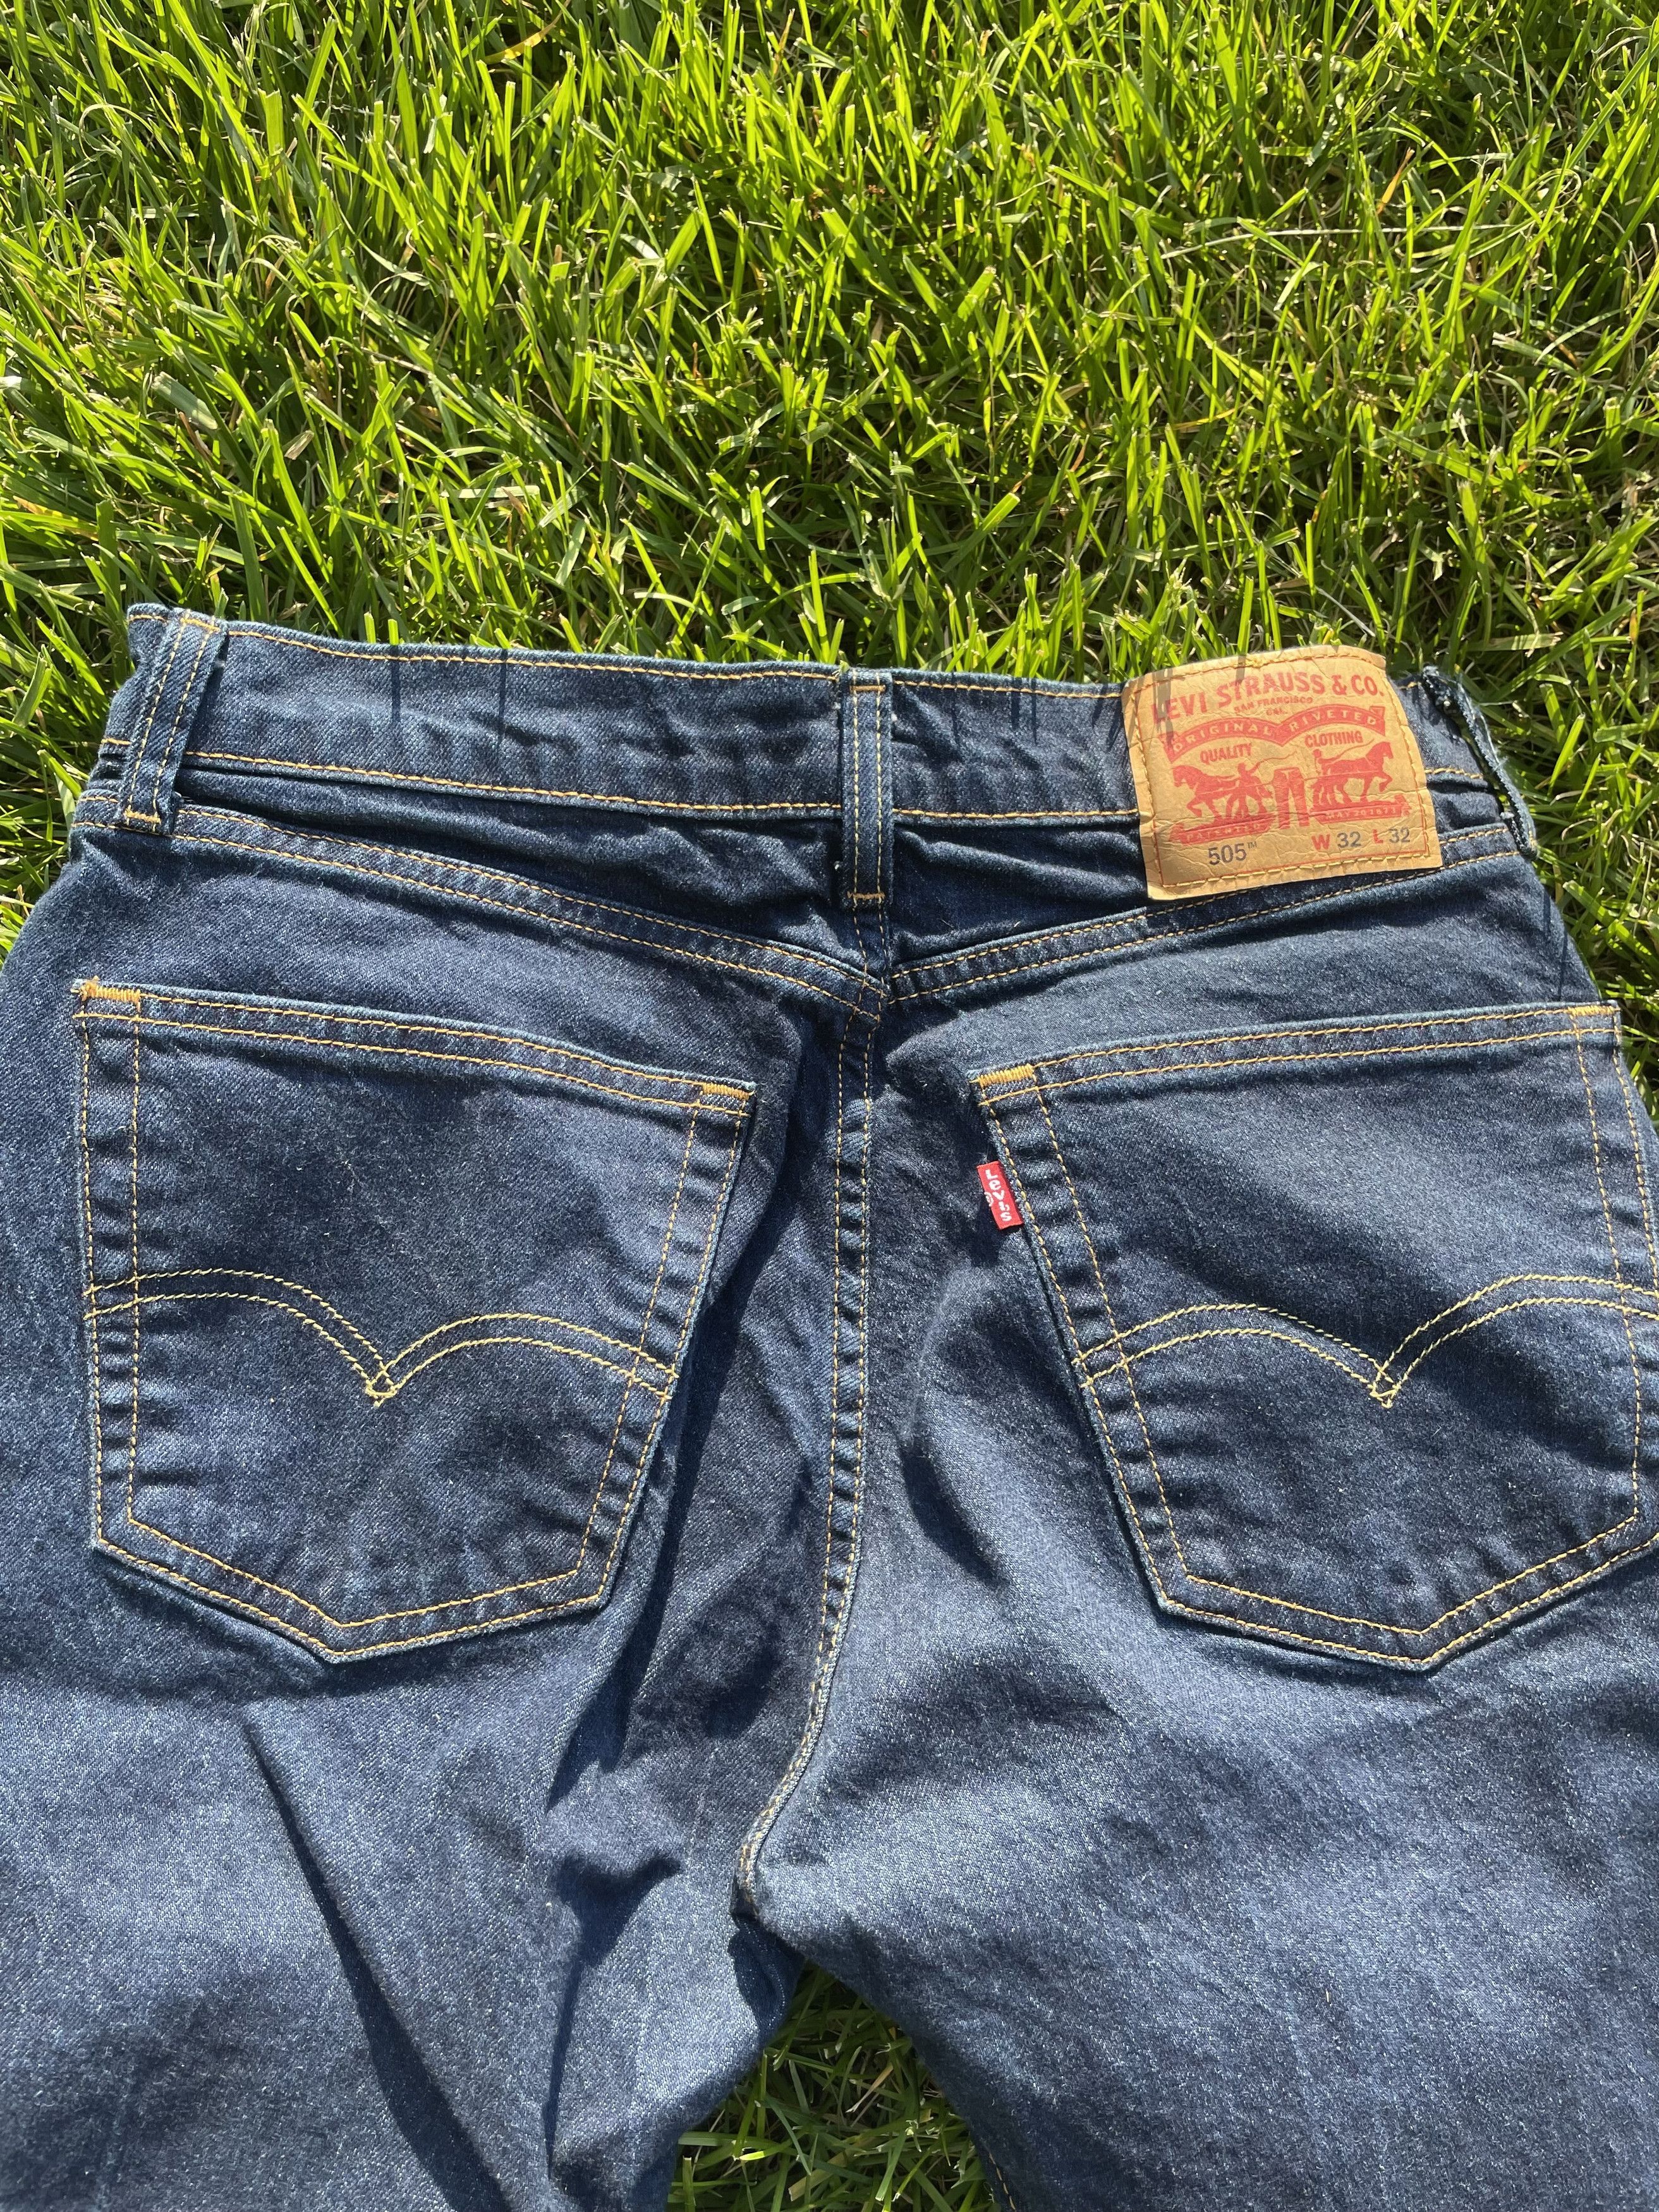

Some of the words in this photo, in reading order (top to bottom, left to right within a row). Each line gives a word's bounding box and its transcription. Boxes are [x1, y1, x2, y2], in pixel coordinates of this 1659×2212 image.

[1151, 692, 1207, 725] LEVI
[1217, 672, 1325, 708] STRAUSS
[1332, 675, 1347, 695] &
[1351, 675, 1384, 696] CO.
[1234, 702, 1255, 714] SAN
[1257, 696, 1313, 707] FRANCISCO
[1173, 722, 1273, 753] ORIGINAL
[1289, 710, 1376, 732] RIVETED
[1304, 730, 1363, 748] CLOTHING
[1200, 743, 1252, 765] QUALITY
[1311, 834, 1330, 850] W
[1337, 831, 1361, 849] 32
[1372, 829, 1383, 844] L
[1389, 827, 1411, 843] 32
